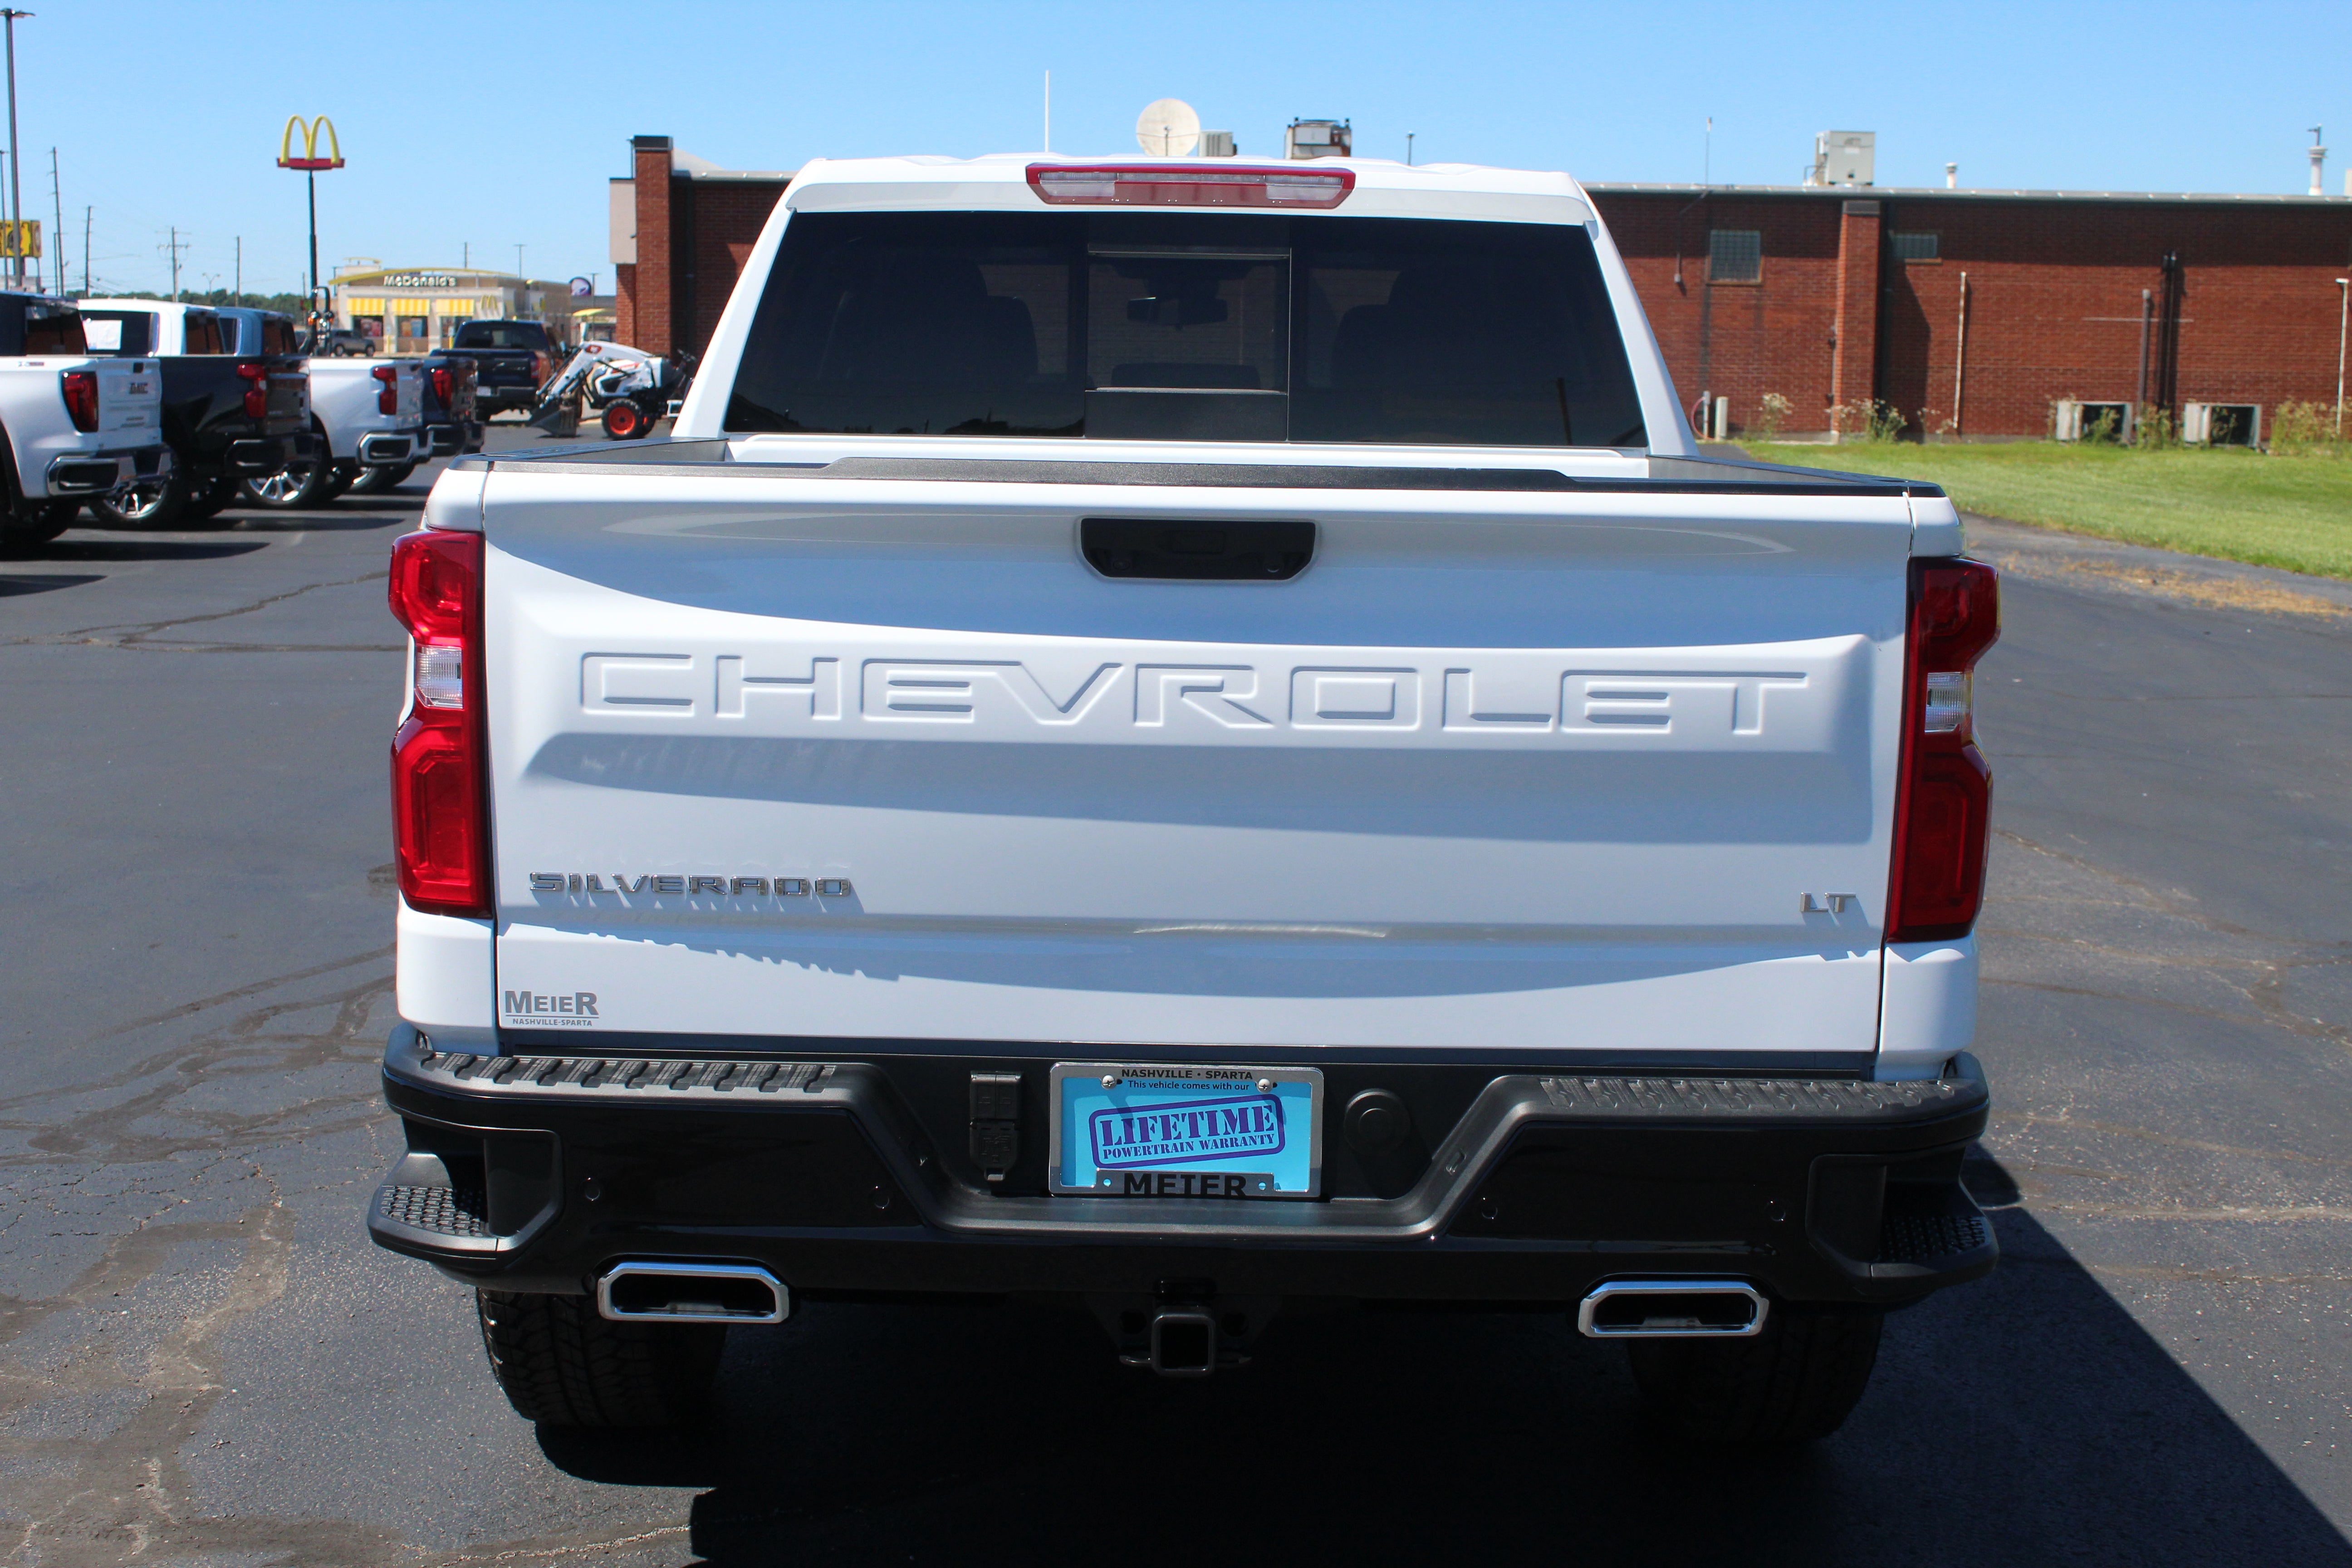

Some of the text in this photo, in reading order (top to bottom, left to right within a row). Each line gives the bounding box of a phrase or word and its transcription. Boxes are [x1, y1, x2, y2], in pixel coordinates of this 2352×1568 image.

[383, 275, 457, 287] McDonald's
[581, 652, 1808, 735] CHEVROLET
[529, 872, 851, 897] SILVERADO
[1799, 892, 1856, 913] LT
[513, 1018, 593, 1026] NASHVILLE-SPARTA
[1122, 1069, 1253, 1079] NASHVILLE SPARTA
[1128, 1080, 1146, 1088] This
[1149, 1080, 1179, 1089] vehicle
[1213, 1082, 1232, 1090] with
[1100, 1105, 1274, 1147] LIFETIME
[1103, 1134, 1274, 1159] POWERTRAIN WARRANTY
[1123, 1172, 1247, 1196] MEIER
